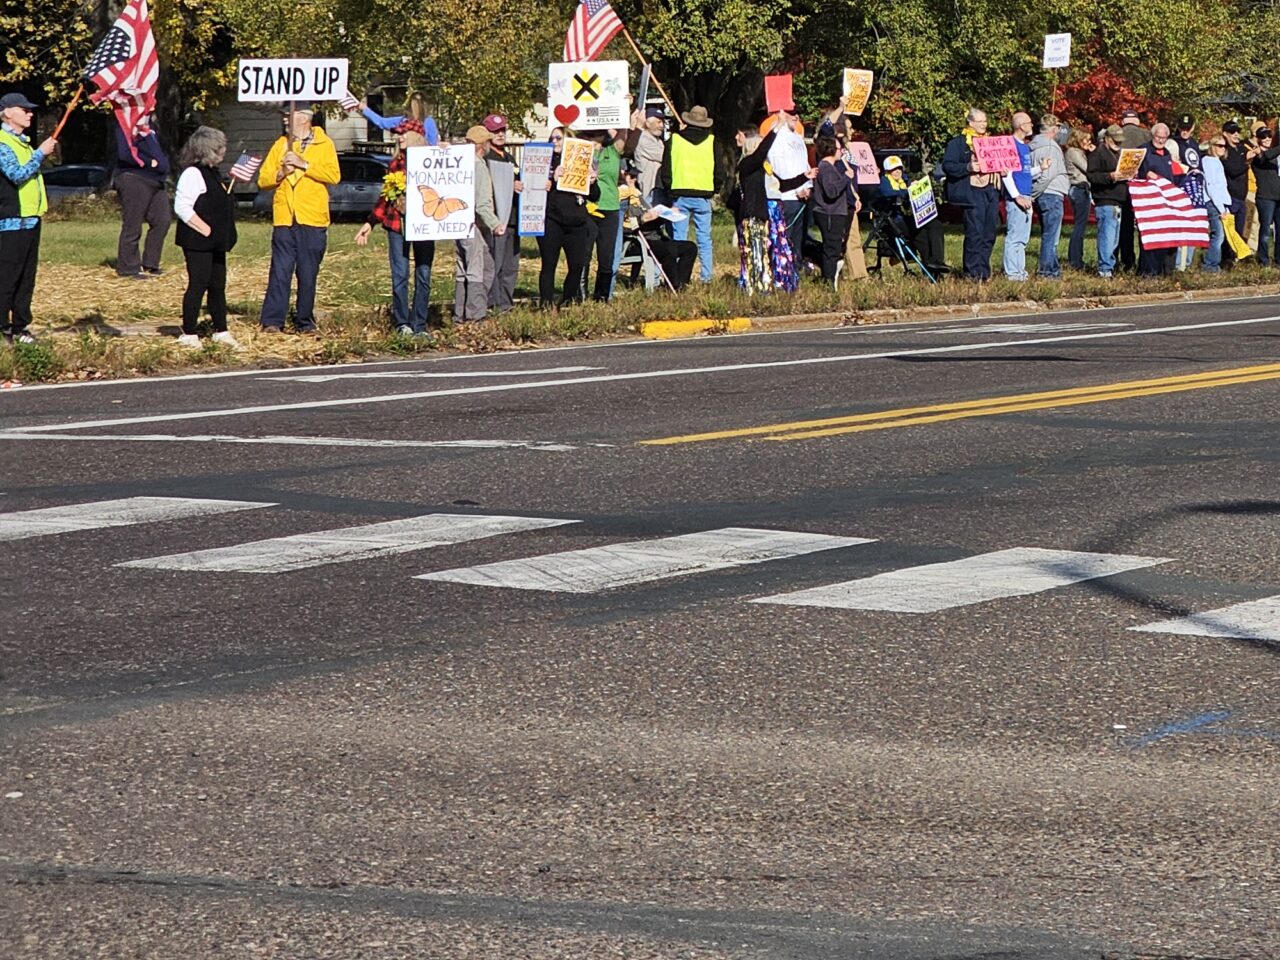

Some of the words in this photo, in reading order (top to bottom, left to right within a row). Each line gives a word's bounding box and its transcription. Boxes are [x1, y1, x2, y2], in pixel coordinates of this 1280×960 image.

[241, 65, 305, 95] STAND
[314, 66, 340, 95] UP
[430, 148, 452, 157] THE
[859, 149, 868, 160] NO
[423, 156, 463, 169] ONLY
[407, 170, 473, 185] MONARCH
[562, 173, 587, 187] 1776
[412, 223, 431, 235] WE
